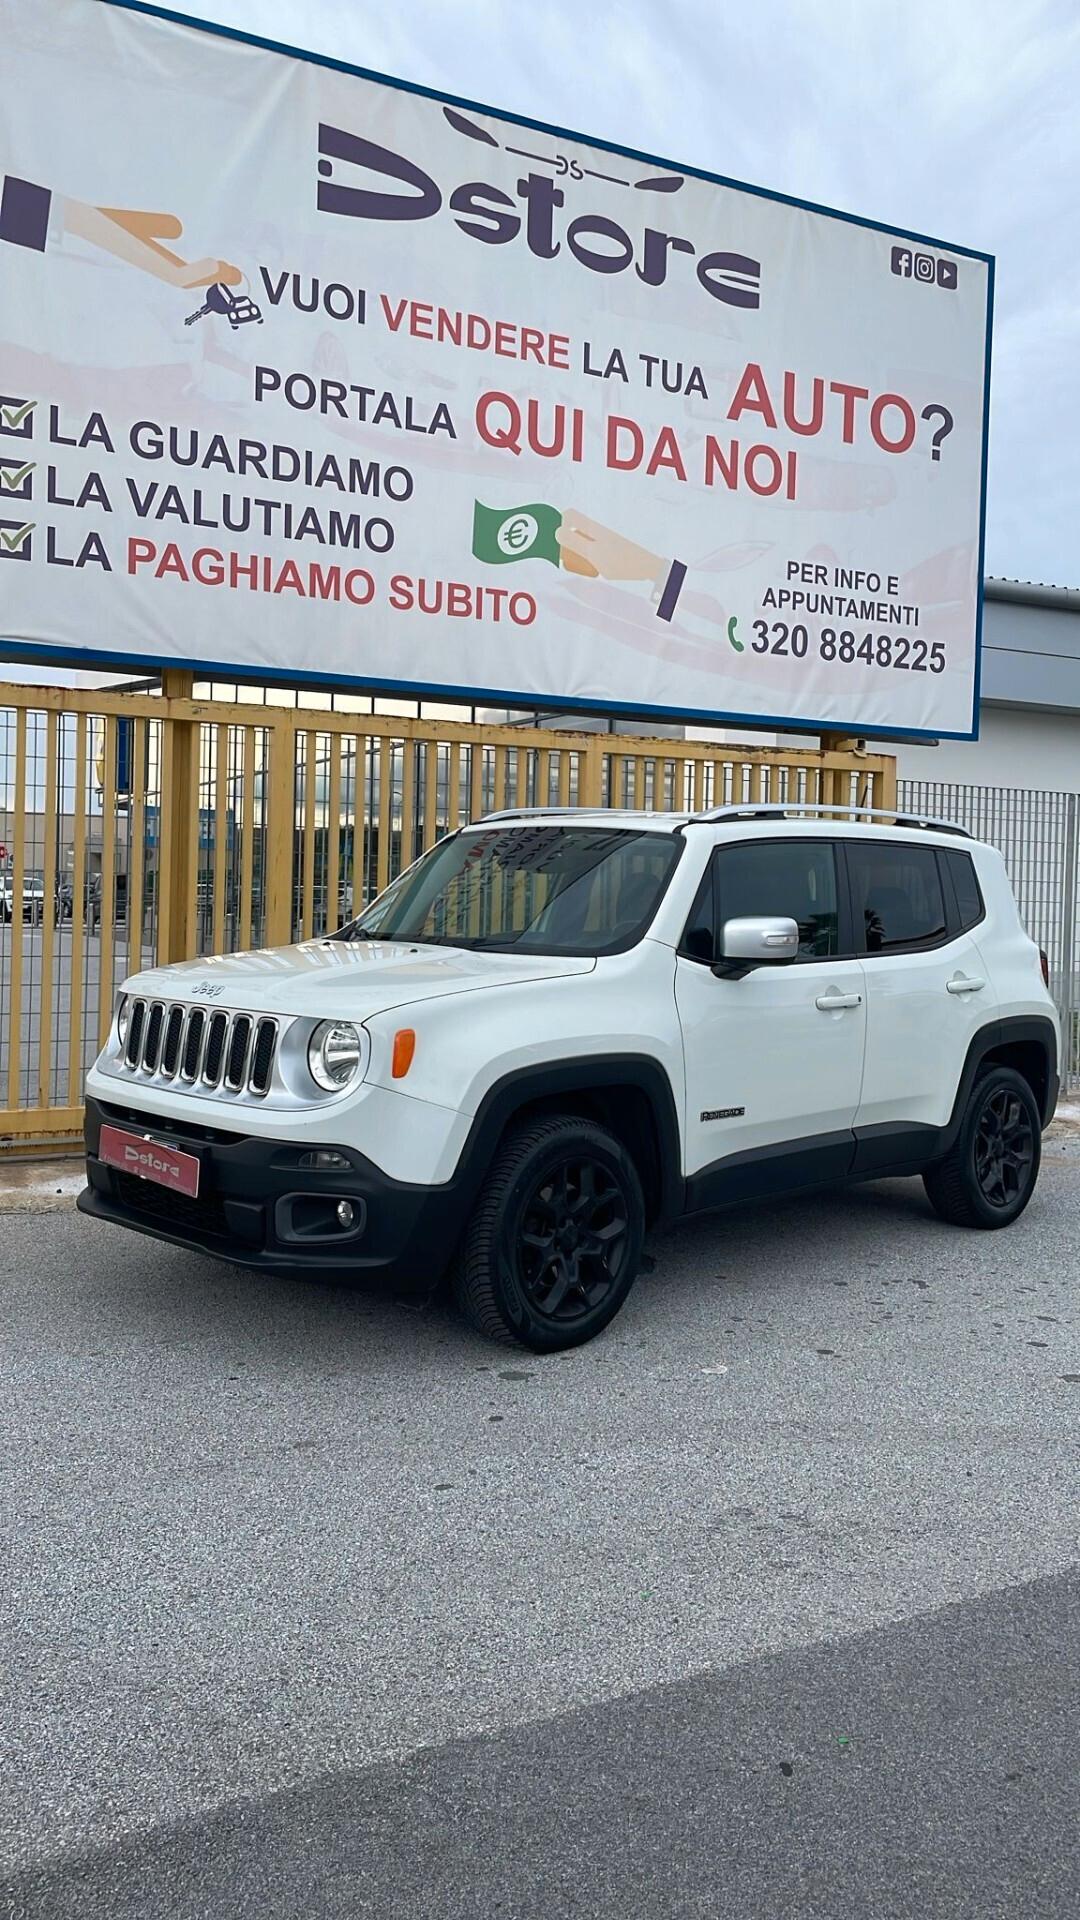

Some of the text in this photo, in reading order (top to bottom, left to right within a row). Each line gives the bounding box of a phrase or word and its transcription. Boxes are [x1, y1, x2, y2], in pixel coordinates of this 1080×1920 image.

[317, 122, 760, 309] Dstore
[260, 266, 954, 461] VUOI VENDERE LA TUA AUTO?
[49, 405, 414, 501] LA GUARDIAMO
[255, 366, 797, 500] PORTALA QUI DA NOI
[47, 466, 395, 553] LA VALUTIAMO
[47, 526, 537, 626] LA PAGHIAMO SUBITO
[762, 587, 919, 627] APPUNTAMENTI
[787, 561, 899, 595] PER INFO E
[751, 620, 946, 673] 320 8848225
[191, 981, 225, 998] Jeep
